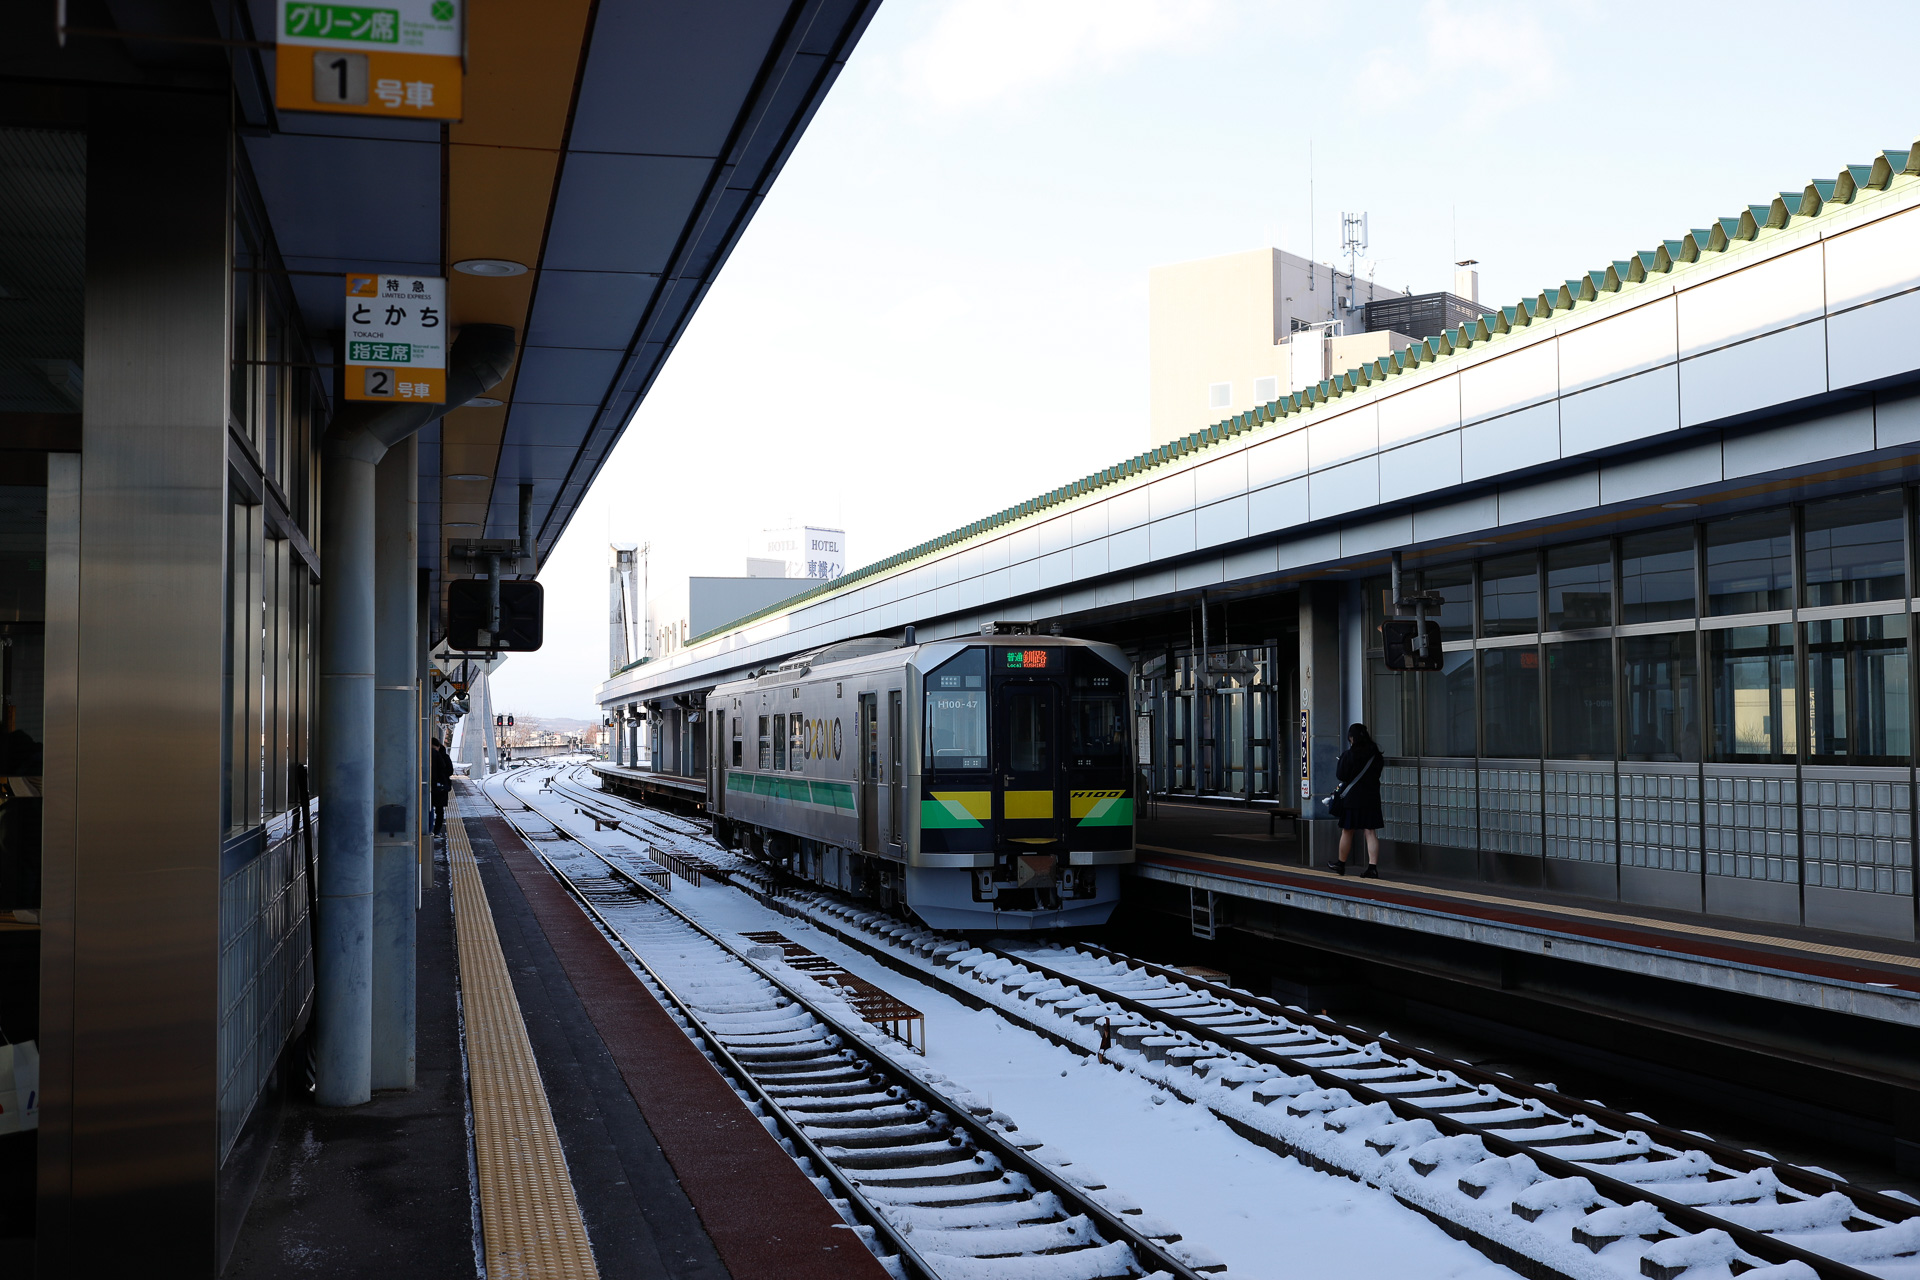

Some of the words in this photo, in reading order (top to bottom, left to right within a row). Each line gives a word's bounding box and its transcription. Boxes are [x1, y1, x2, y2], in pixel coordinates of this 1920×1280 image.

[289, 6, 395, 41] グリーン席
[330, 58, 348, 100] 1
[374, 79, 435, 109] 号車
[386, 279, 425, 293] 特急
[352, 303, 439, 328] とかち
[353, 343, 409, 361] 指定席
[371, 371, 389, 395] 2
[397, 382, 430, 398] 号車
[768, 541, 798, 552] HOTEL
[812, 540, 838, 552] HOTEL
[808, 560, 844, 578] 東横イン
[1007, 652, 1023, 662] 普通
[1023, 650, 1047, 664] 釧路
[937, 700, 978, 709] H100-47
